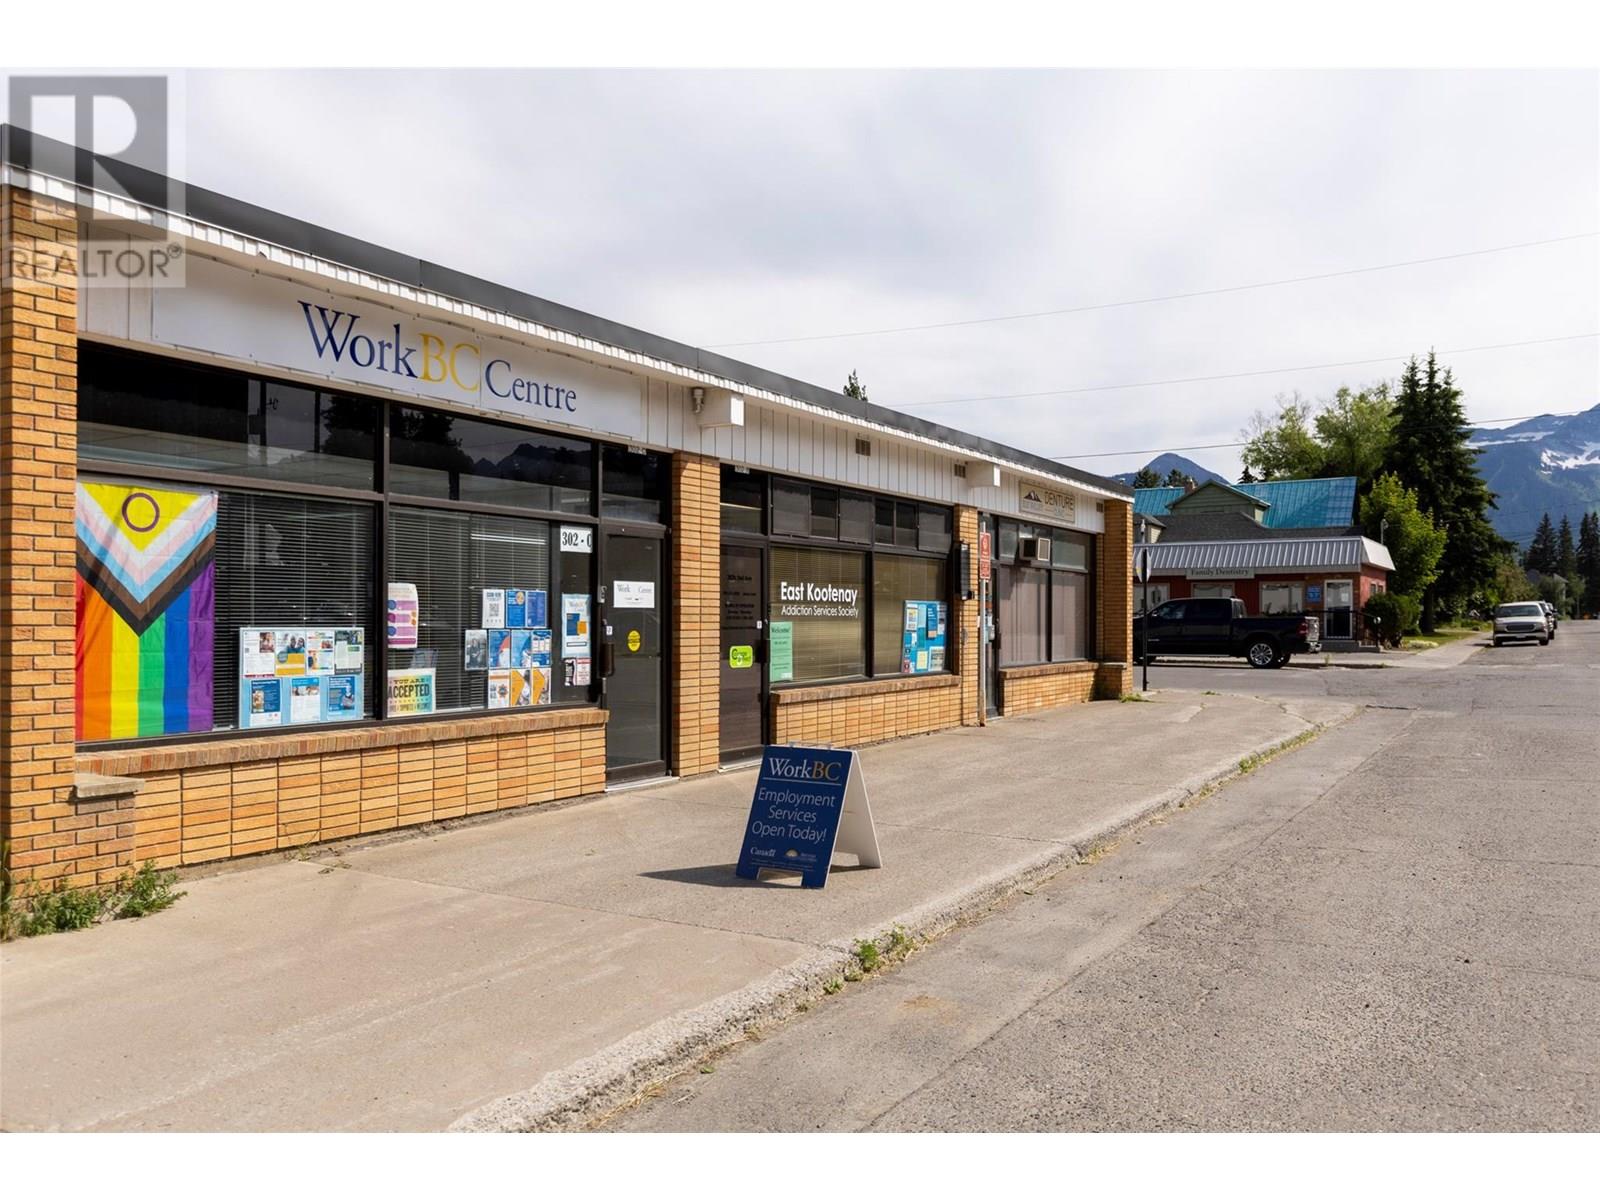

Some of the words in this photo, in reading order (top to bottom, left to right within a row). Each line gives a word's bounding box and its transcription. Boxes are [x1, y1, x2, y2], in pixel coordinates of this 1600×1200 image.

[485, 359, 577, 412] Centre
[1044, 491, 1074, 510] DENTURE
[1191, 568, 1214, 577] Family
[1215, 568, 1250, 577] Dentistry
[781, 582, 805, 601] East
[807, 583, 858, 606] Kootenay
[781, 604, 813, 616] Addiction
[813, 605, 838, 616] Services
[838, 605, 859, 618] Society
[769, 757, 842, 781] WorkBC
[758, 787, 836, 807] Employment
[768, 805, 817, 823] Services
[752, 821, 785, 838] Open
[787, 824, 828, 844] Today!
